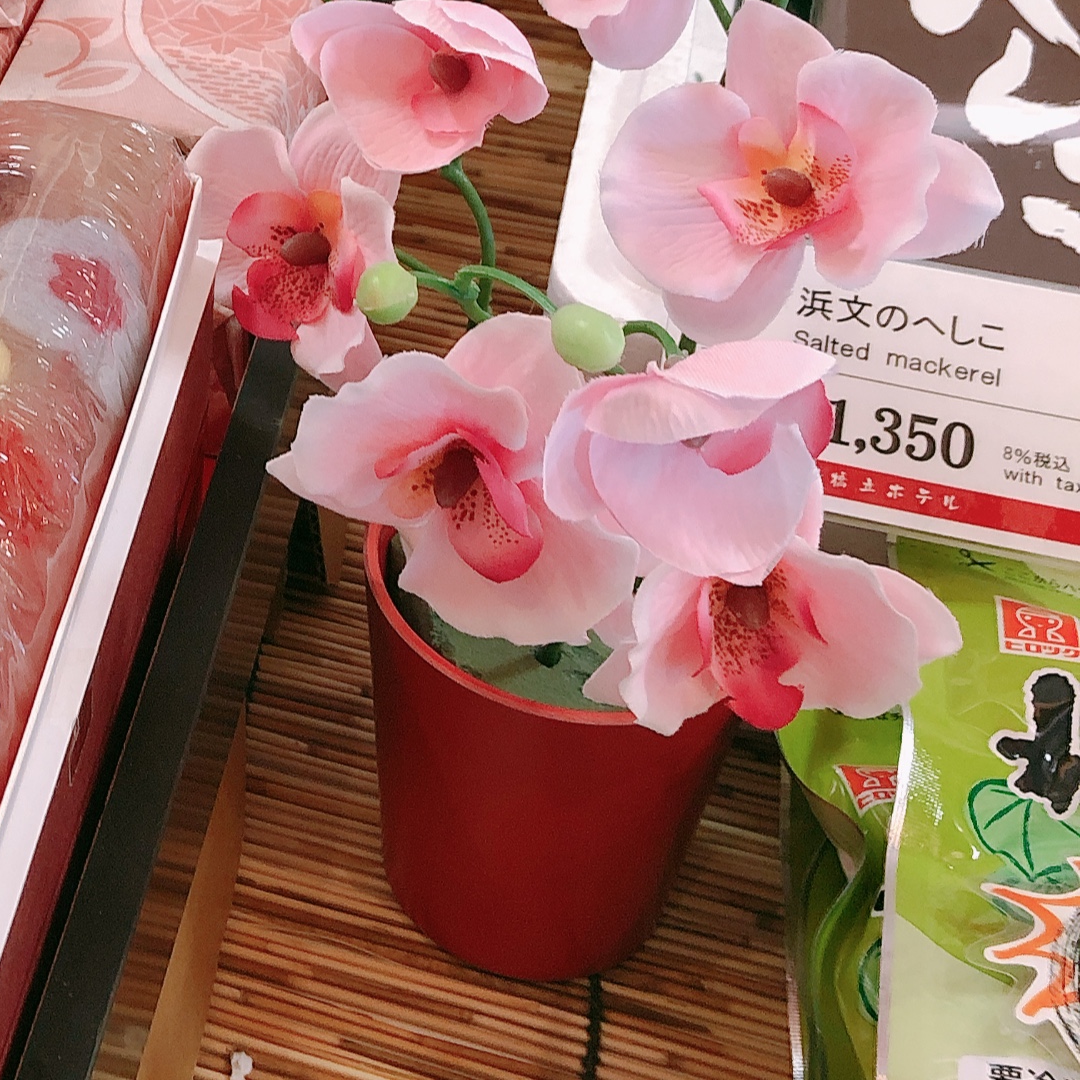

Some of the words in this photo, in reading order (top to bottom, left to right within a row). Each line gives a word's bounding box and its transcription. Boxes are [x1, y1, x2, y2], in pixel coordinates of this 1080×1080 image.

[796, 286, 1005, 352] 浜文のへしこ
[886, 352, 1002, 387] mackerel
[1002, 445, 1071, 473] 8%税込
[1003, 468, 1043, 487] with
